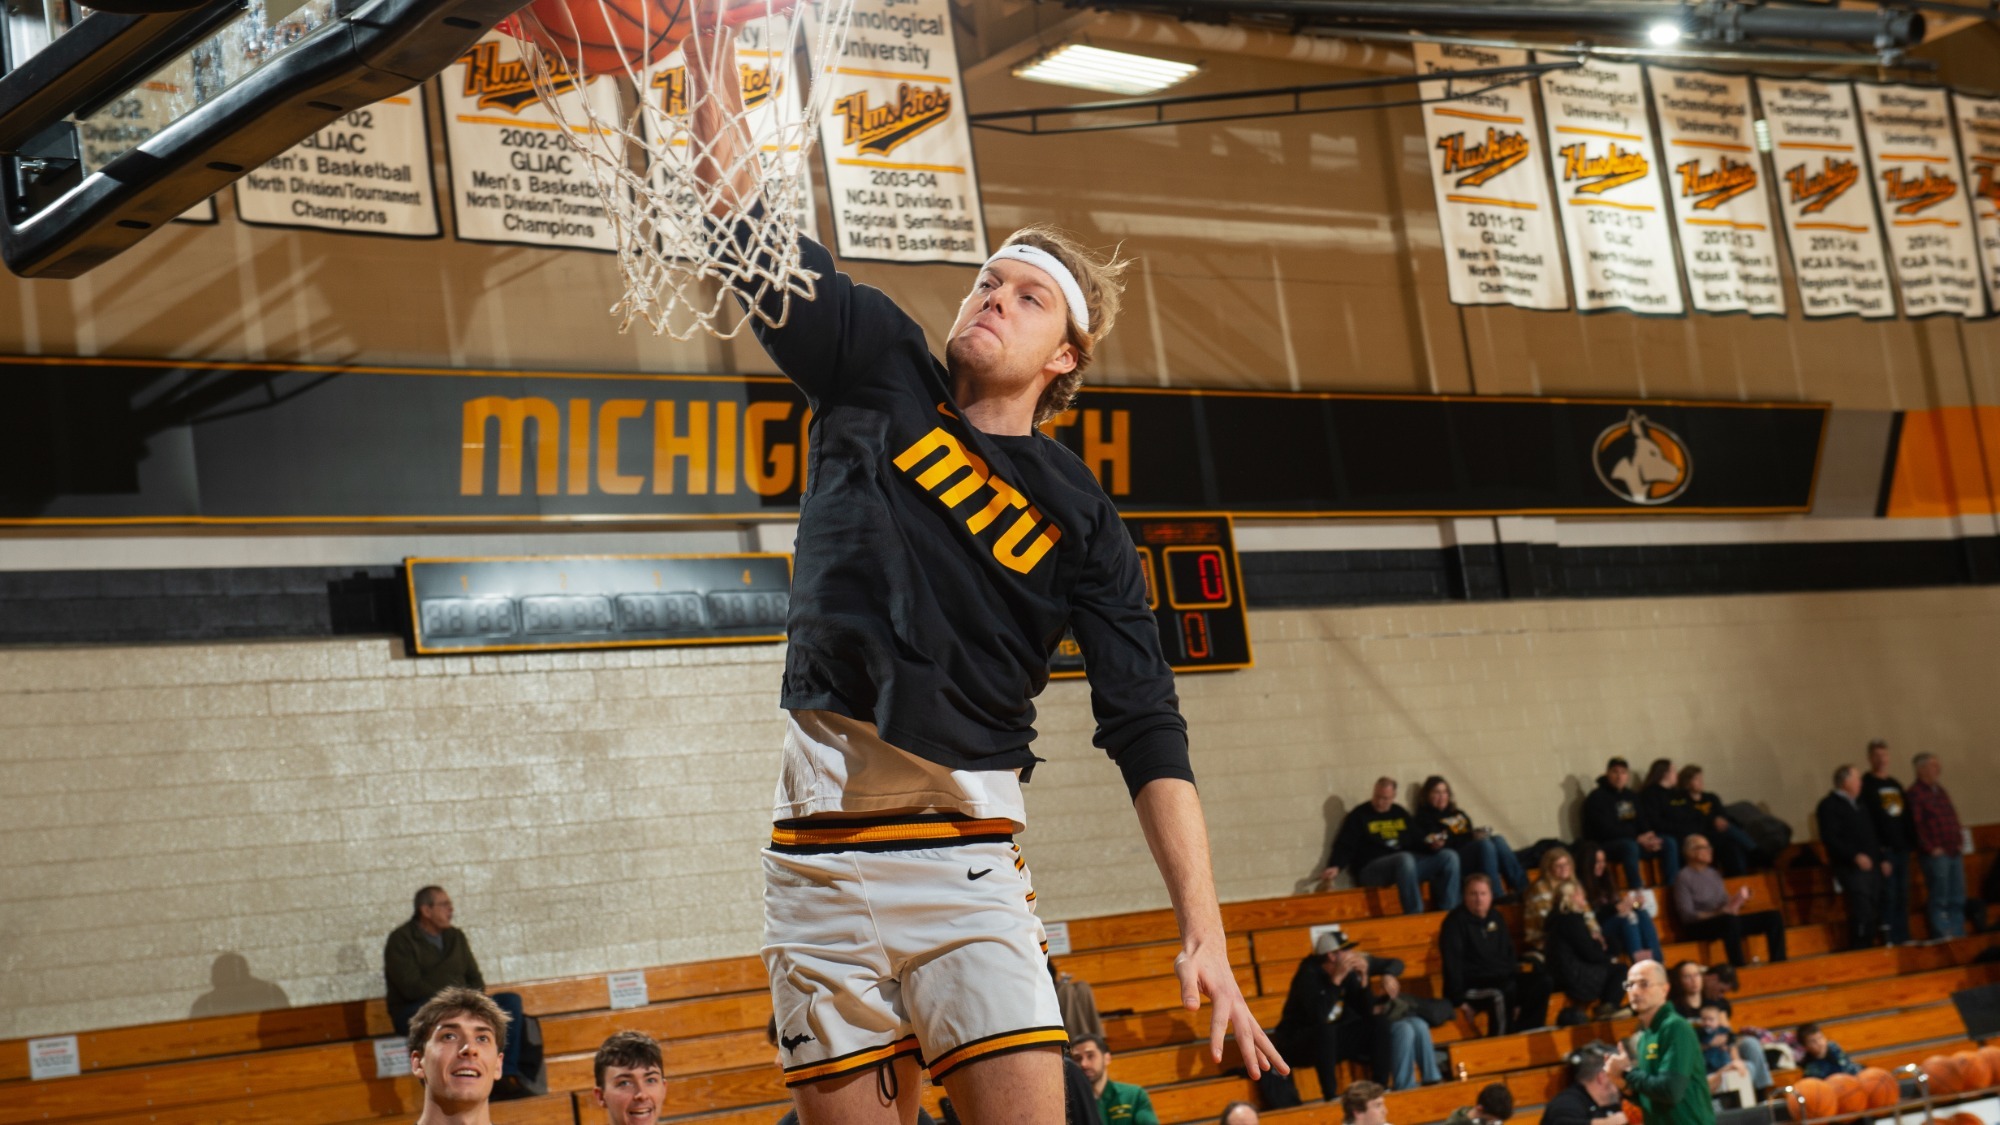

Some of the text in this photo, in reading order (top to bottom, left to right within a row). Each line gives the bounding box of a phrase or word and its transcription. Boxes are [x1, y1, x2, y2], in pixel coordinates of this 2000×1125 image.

[832, 82, 952, 157] Huskies
[317, 157, 411, 182] Basketball
[511, 151, 573, 175] GLIAC
[247, 174, 421, 206] North Division/Tournament
[472, 171, 521, 191] Men's
[870, 170, 938, 188] 2003-04
[466, 191, 502, 210] North
[846, 189, 889, 207] NCAA
[895, 192, 952, 209] Division
[292, 200, 387, 225] Champions
[843, 210, 897, 230] Regional
[1467, 211, 1525, 231] 2011-12
[503, 213, 595, 239] Champions
[849, 231, 976, 252] Men's Basketball
[460, 394, 815, 497] MICHIG
[892, 427, 1062, 574] MTU
[741, 569, 752, 585] 4
[1198, 554, 1224, 600] 0
